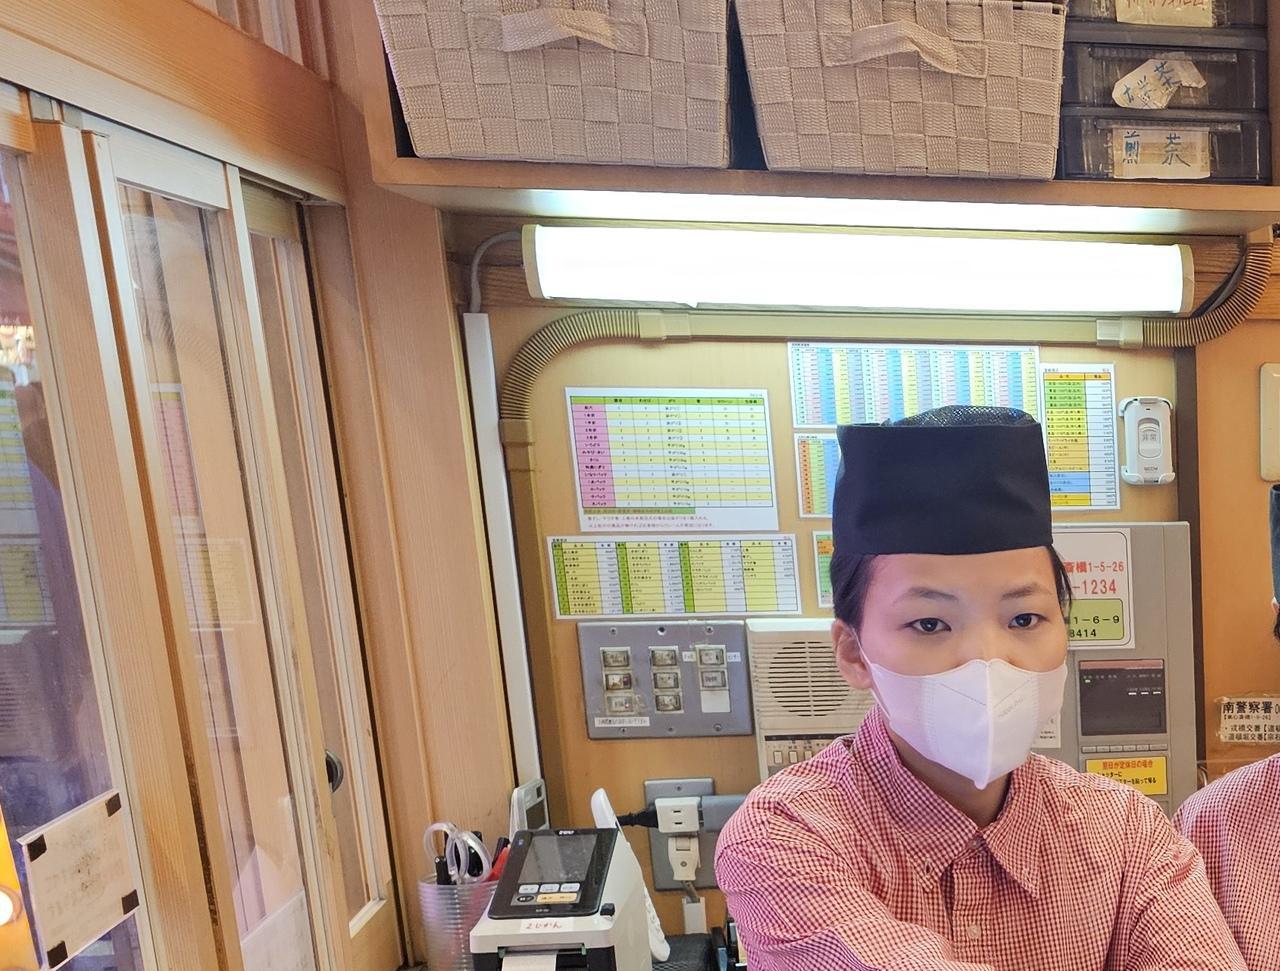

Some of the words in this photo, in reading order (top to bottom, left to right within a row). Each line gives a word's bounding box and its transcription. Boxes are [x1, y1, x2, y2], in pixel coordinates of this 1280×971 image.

[1122, 131, 1191, 167] 煎茶
[1222, 701, 1274, 714] 南警察署
